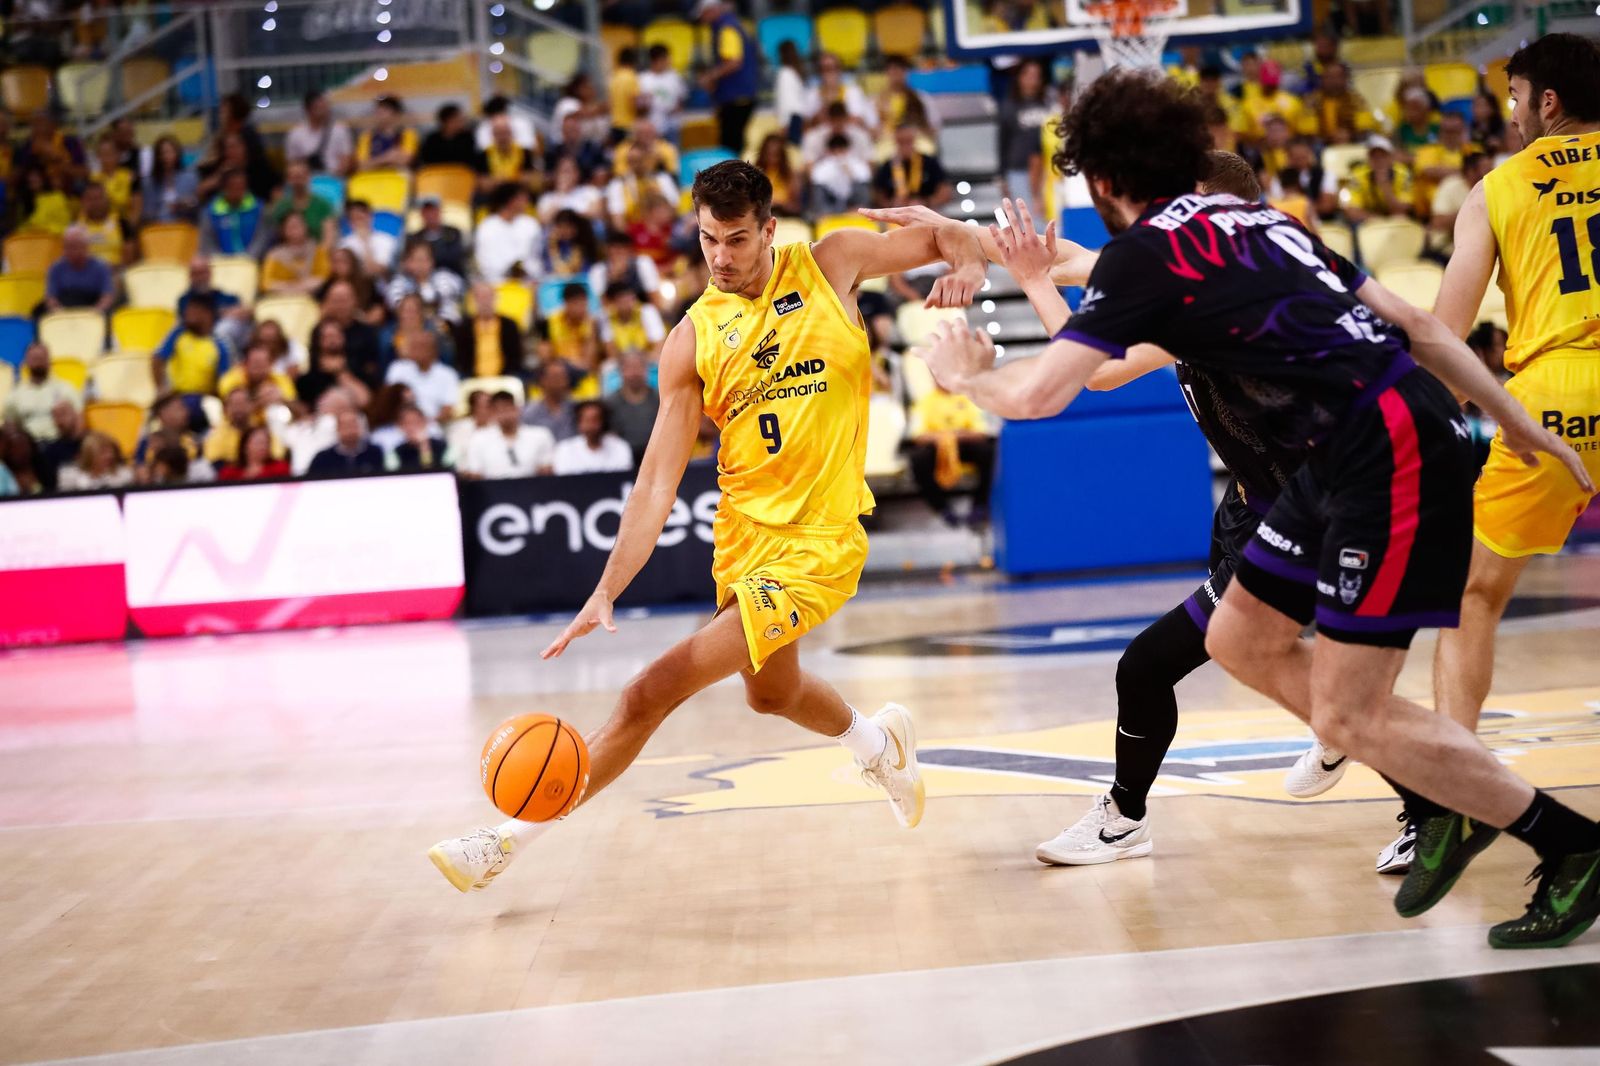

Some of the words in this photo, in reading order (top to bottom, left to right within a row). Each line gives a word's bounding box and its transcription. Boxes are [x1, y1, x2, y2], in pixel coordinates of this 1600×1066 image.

[1265, 225, 1348, 293] 9
[778, 301, 802, 314] endesa
[758, 413, 782, 455] 9
[1570, 441, 1600, 452] OTE
[1203, 577, 1223, 608] ERNE
